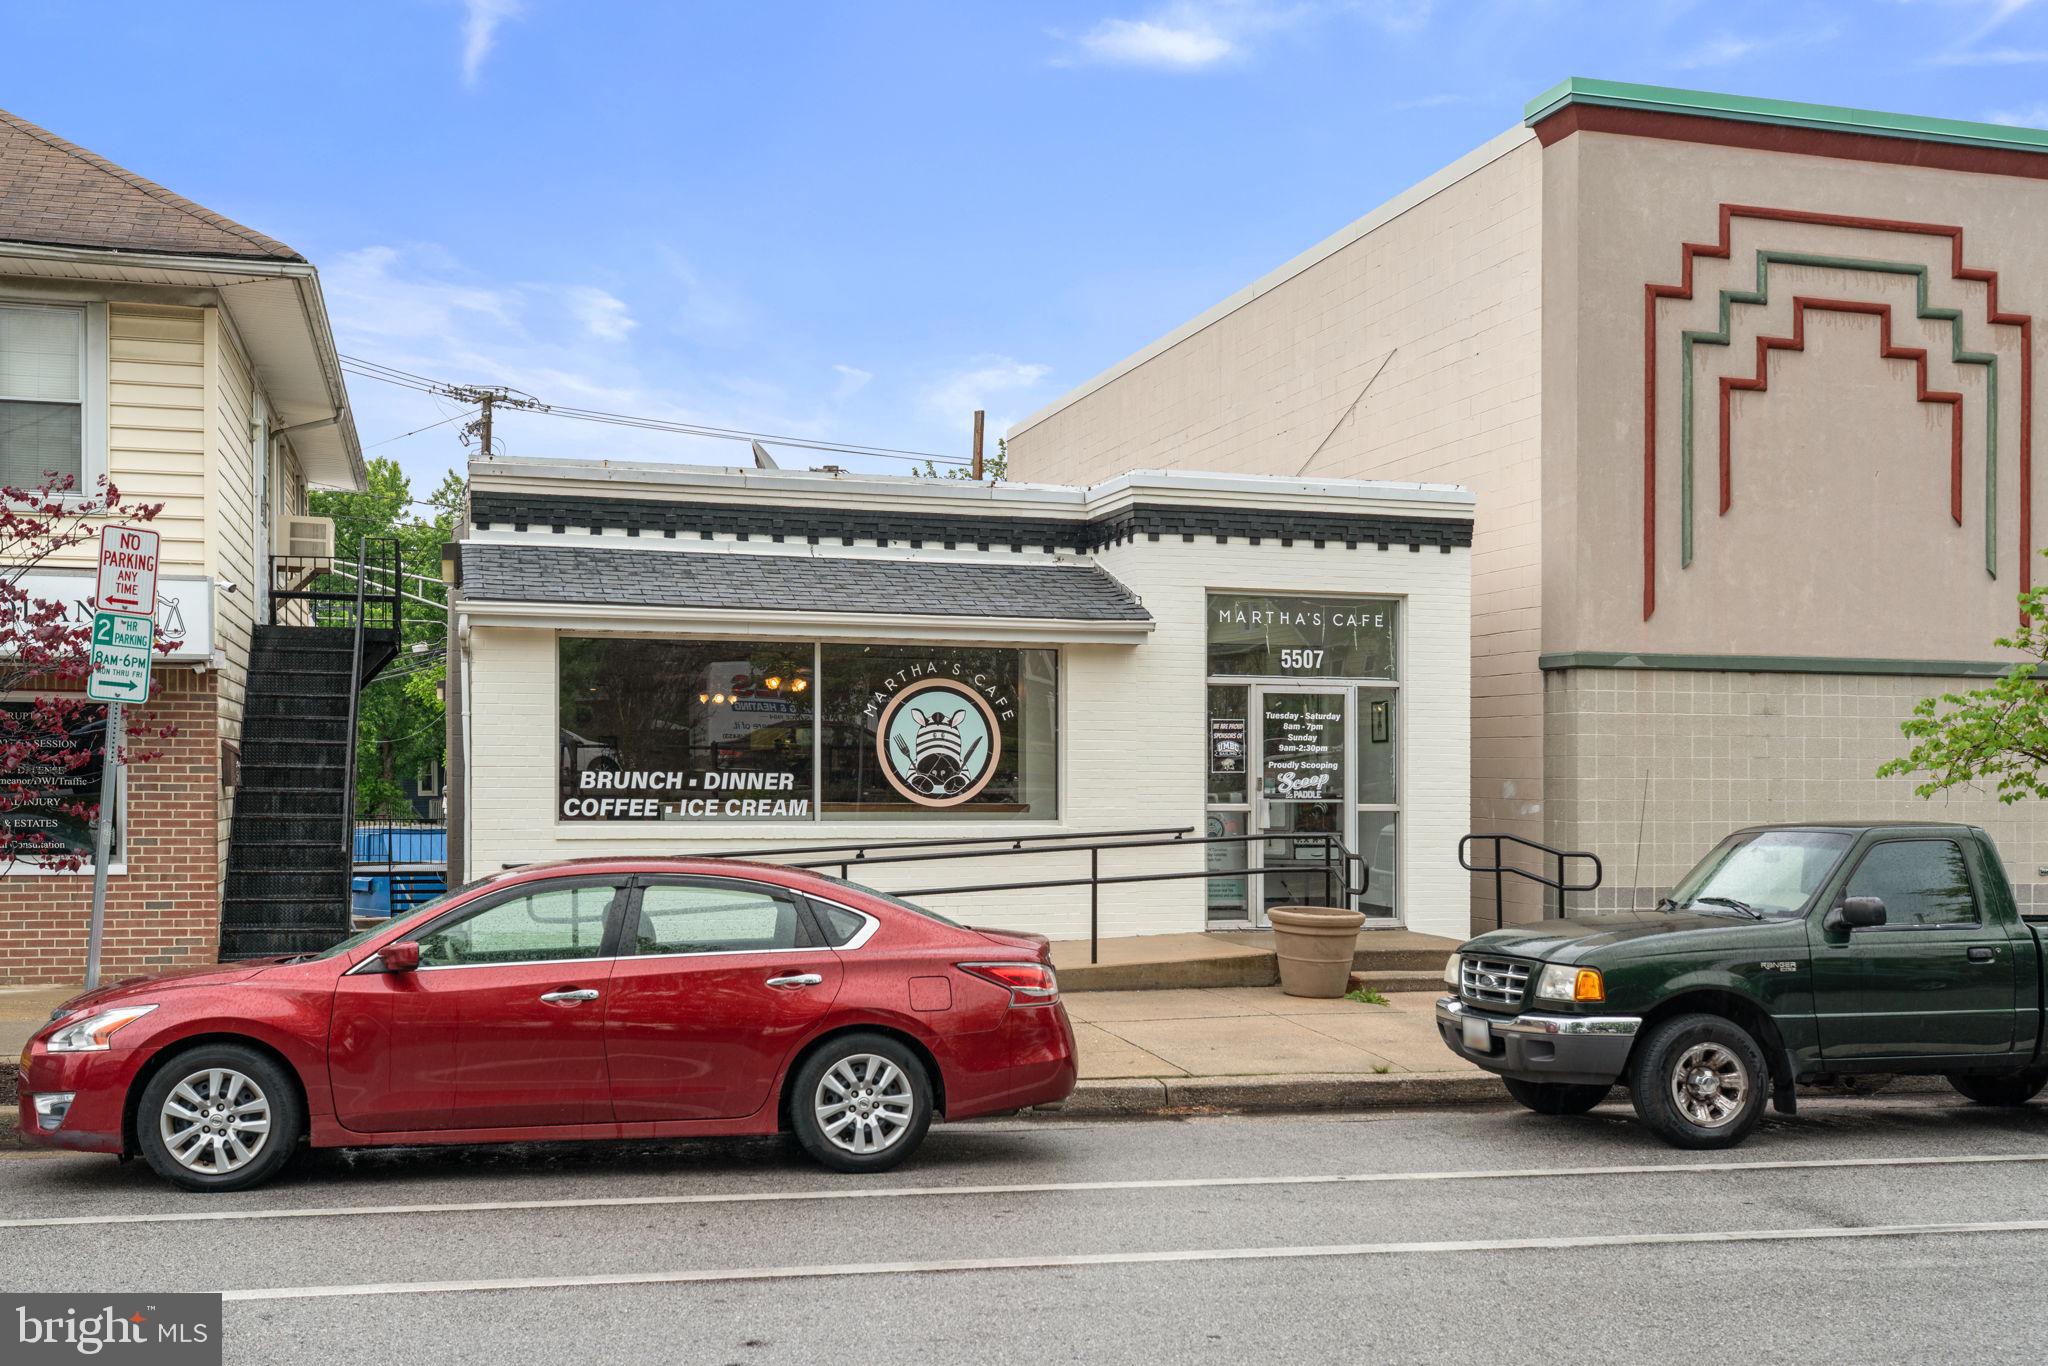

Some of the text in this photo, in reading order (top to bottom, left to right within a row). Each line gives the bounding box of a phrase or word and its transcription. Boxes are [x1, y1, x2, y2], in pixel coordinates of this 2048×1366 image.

[120, 533, 141, 551] NO
[103, 550, 154, 572] PARKING
[117, 570, 138, 582] ANY
[116, 582, 139, 595] TIME
[1219, 610, 1384, 628] MARTHA'S CAFE
[97, 619, 138, 641] 2 HR
[114, 633, 148, 646] PARKING
[1281, 649, 1324, 669] 5507
[113, 668, 130, 677] THRU
[132, 670, 143, 678] FRI
[863, 660, 1014, 721] MARTHA'S CAFE
[1265, 711, 1299, 721] Tuesday
[1305, 712, 1341, 722] Saturday
[1283, 722, 1300, 730] 8am
[1306, 723, 1323, 731] 7pm
[1287, 733, 1318, 742] Sunday
[1278, 744, 1328, 753] 9am-2:30pm
[1268, 761, 1338, 770] Proudly Scooping
[580, 771, 795, 790] BRUNCH DINNER
[1277, 771, 1329, 793] Scoop
[1293, 790, 1322, 799] PADDLE
[563, 797, 808, 817] COFFEE ICE CREAM
[14, 819, 58, 828] ESTATES
[1760, 961, 1797, 970] RANGER
